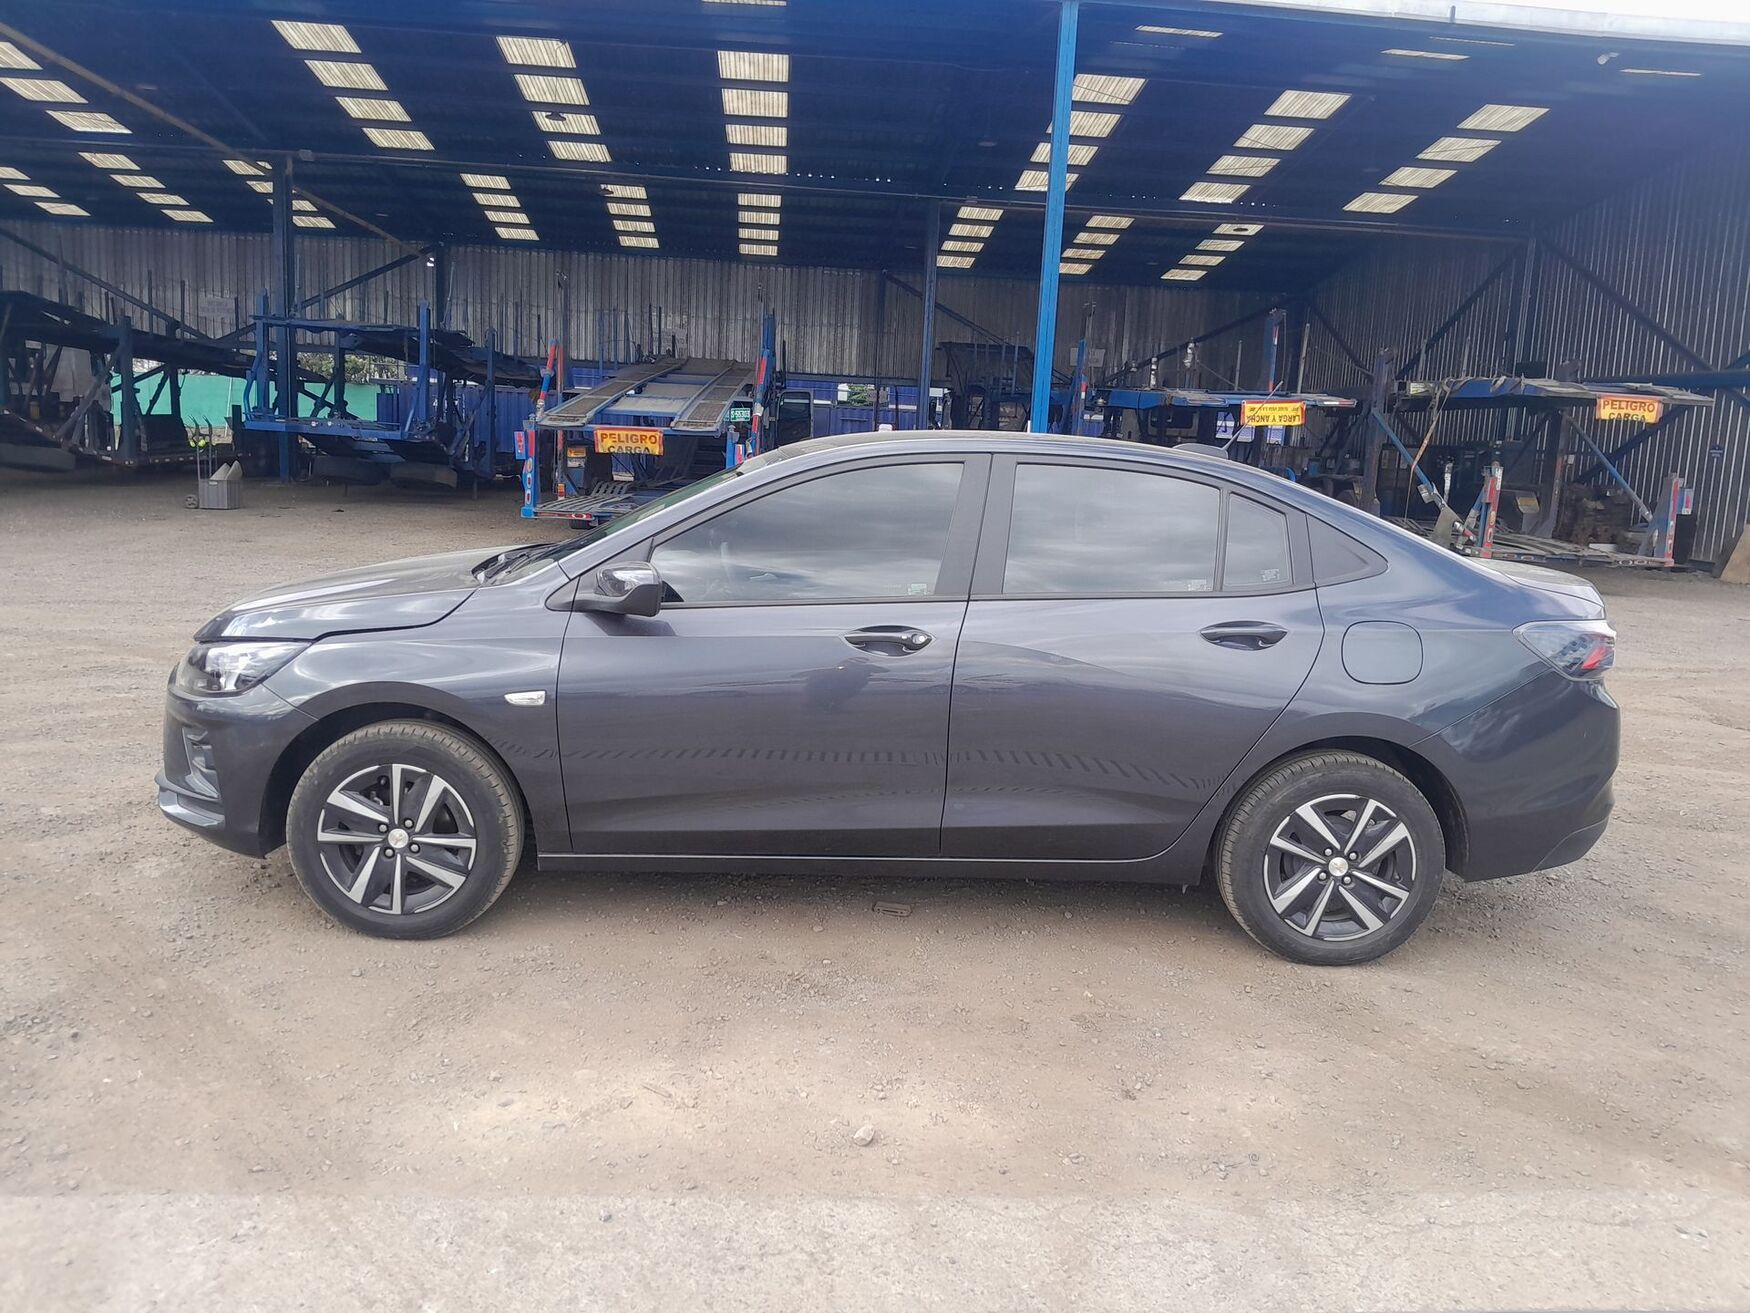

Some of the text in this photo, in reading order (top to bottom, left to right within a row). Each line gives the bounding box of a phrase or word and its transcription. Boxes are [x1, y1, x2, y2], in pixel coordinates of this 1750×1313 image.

[1602, 400, 1655, 413] PELIGRO
[1271, 414, 1277, 422] Y
[1278, 414, 1300, 422] LARGA
[1608, 412, 1646, 421] CARGA
[600, 433, 657, 444] PELIGRO
[607, 445, 650, 454] CARGA
